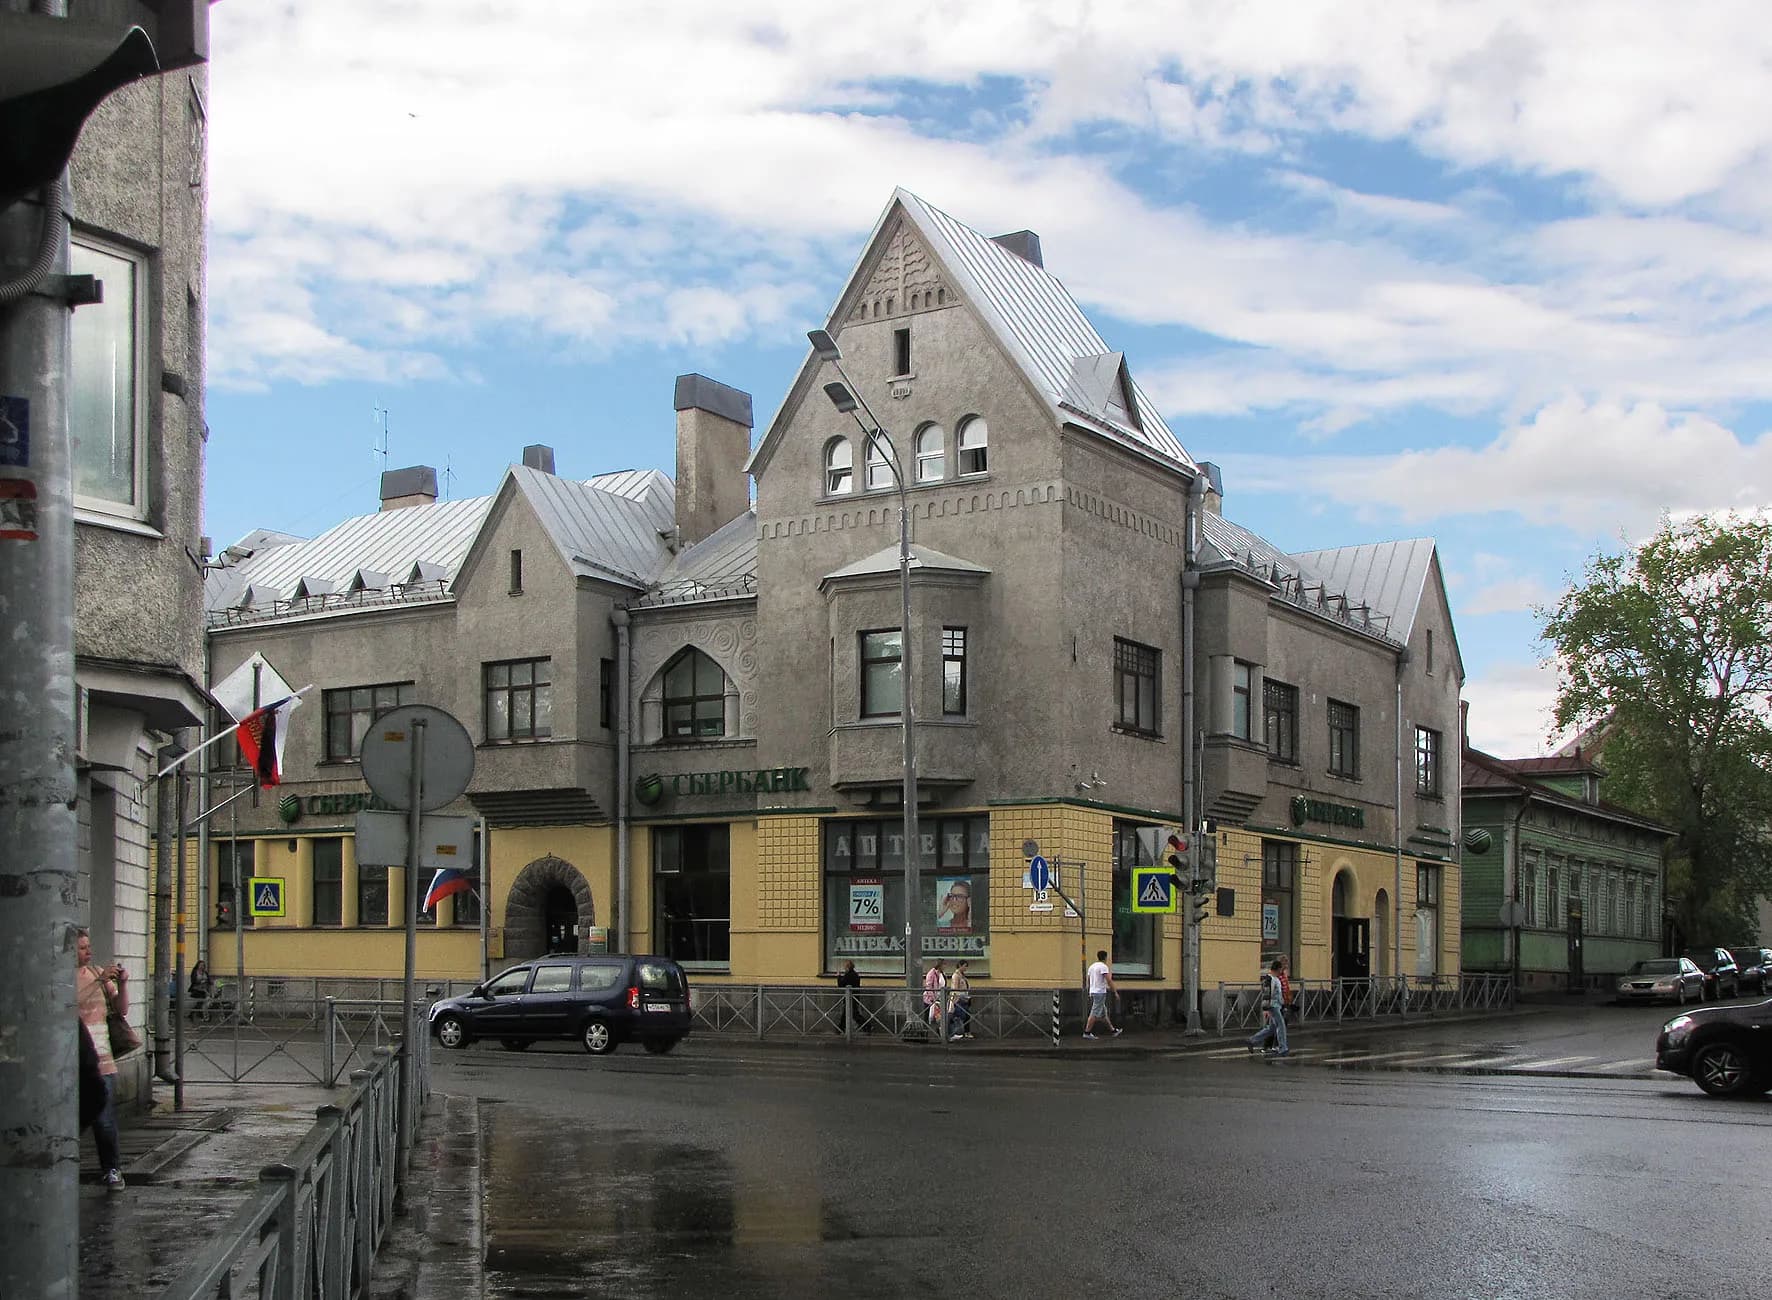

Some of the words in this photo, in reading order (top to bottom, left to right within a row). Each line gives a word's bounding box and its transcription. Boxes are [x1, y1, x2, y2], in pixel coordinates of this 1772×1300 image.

[673, 767, 809, 795] СБЕРБАНК
[853, 899, 879, 914] 7%
[835, 936, 899, 951] АПТЕКА
[921, 936, 986, 951] НЕВИС
